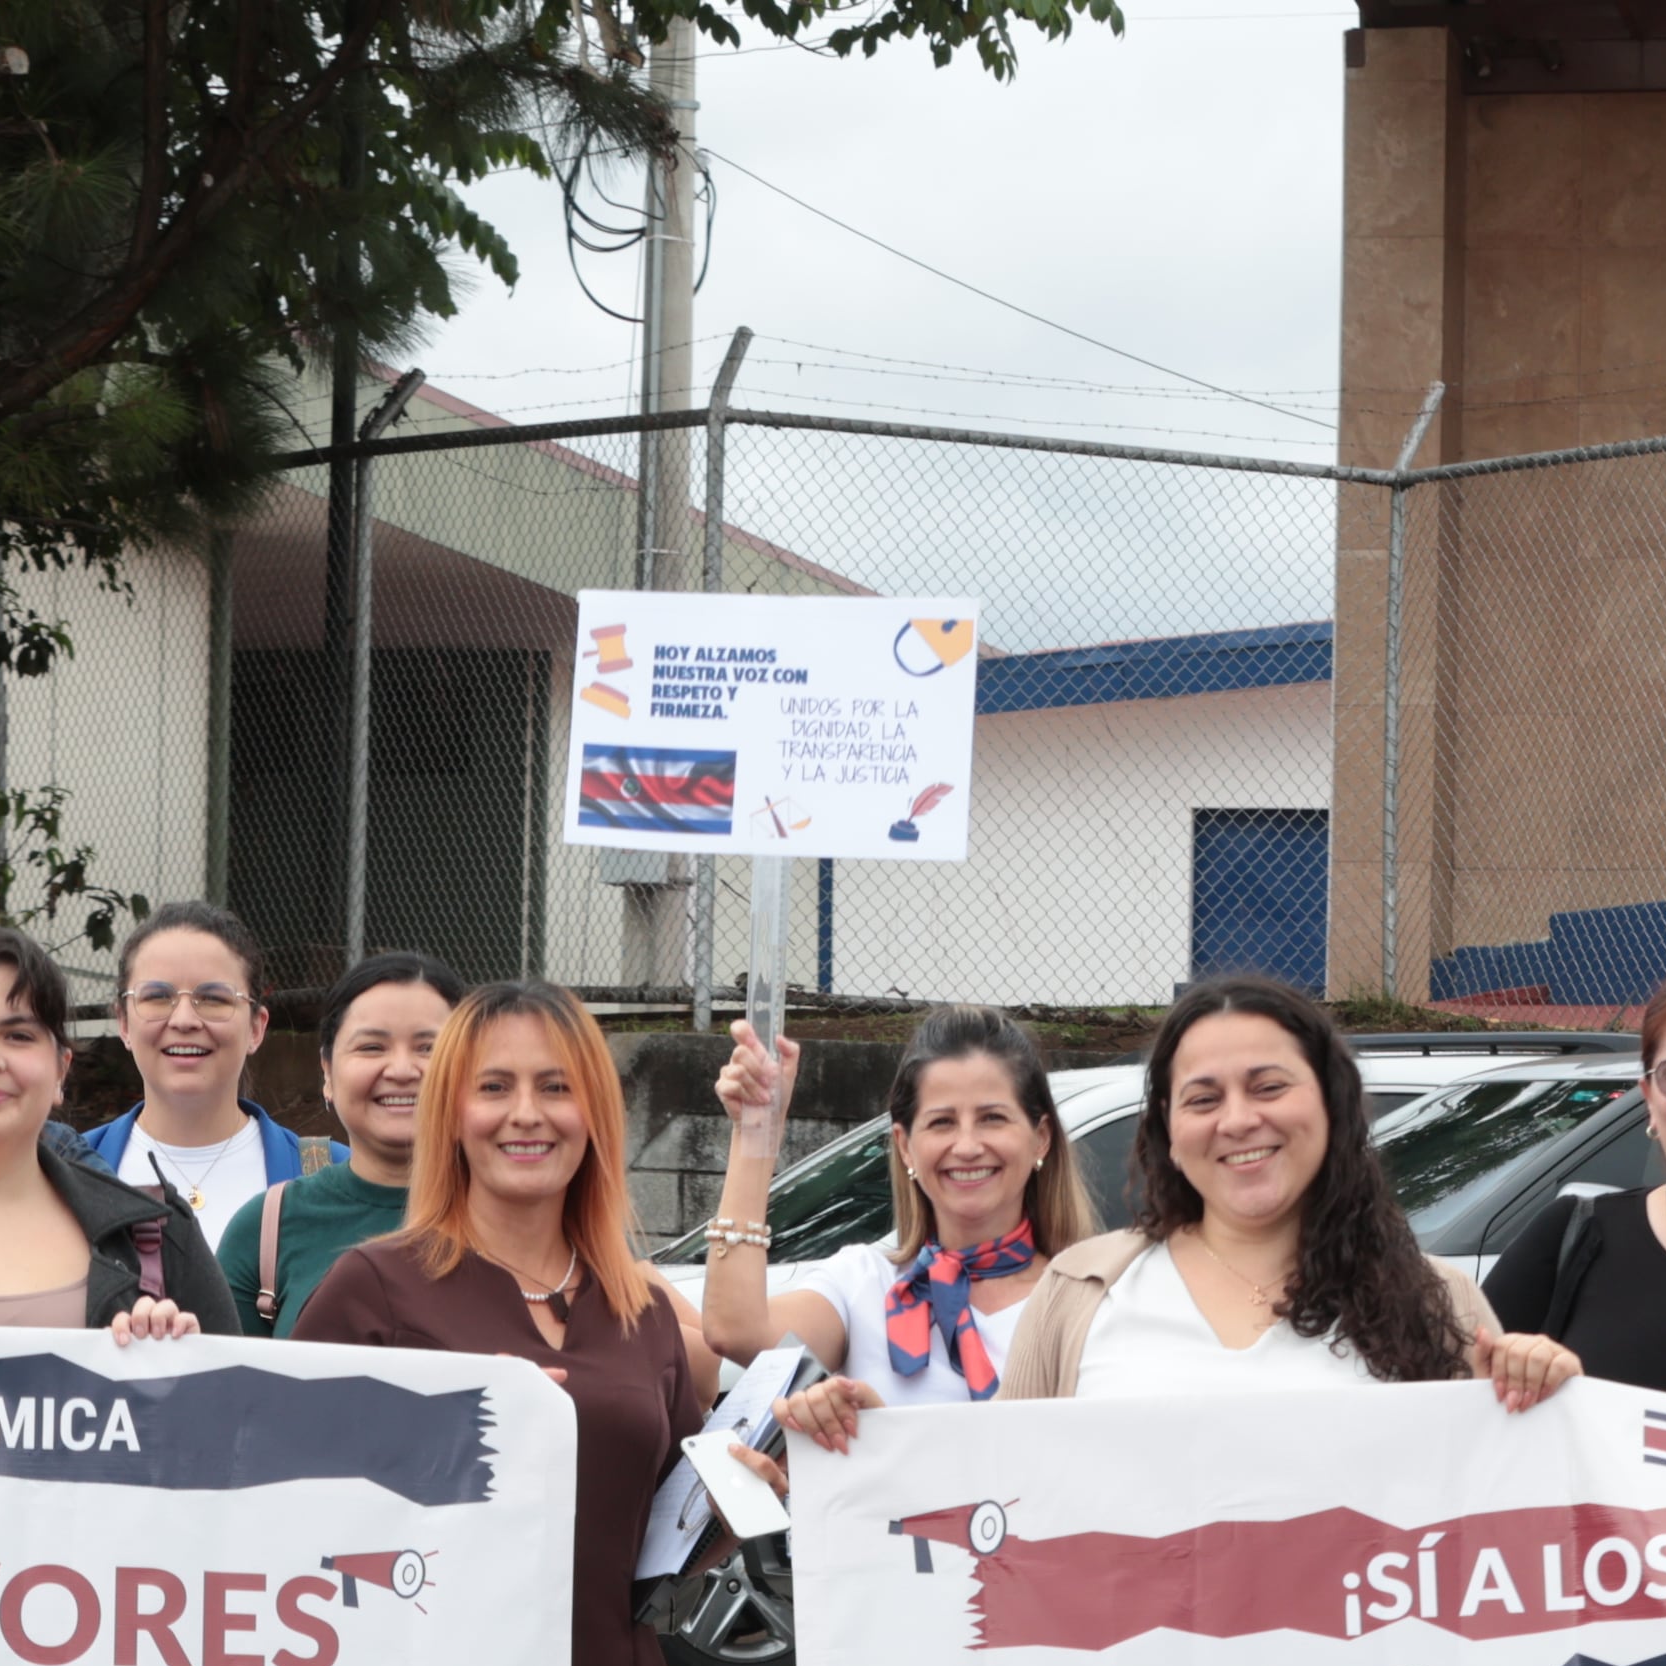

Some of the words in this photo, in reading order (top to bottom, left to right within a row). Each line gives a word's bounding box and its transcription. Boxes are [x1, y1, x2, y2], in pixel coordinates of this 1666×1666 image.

[654, 645, 690, 661] HOY
[695, 647, 777, 664] ALZAMOS
[653, 664, 728, 682] NUESTRA
[733, 667, 769, 683] VOZ
[772, 668, 808, 684] CON
[651, 684, 723, 701] RESPETO
[727, 686, 738, 701] Y
[650, 702, 728, 719] FIRMEZA.
[780, 698, 841, 717] UNIDOS
[852, 699, 885, 718] POR
[894, 700, 918, 719] LA
[791, 719, 872, 741] DIGNIDAD,
[882, 721, 906, 740] LA
[777, 740, 917, 762] TRANSPARENCIA
[781, 763, 793, 780] Y
[801, 763, 826, 782] LA
[835, 764, 909, 784] JUSTICIA
[1343, 1531, 1443, 1638] ¡SÍ
[1459, 1548, 1525, 1616] A
